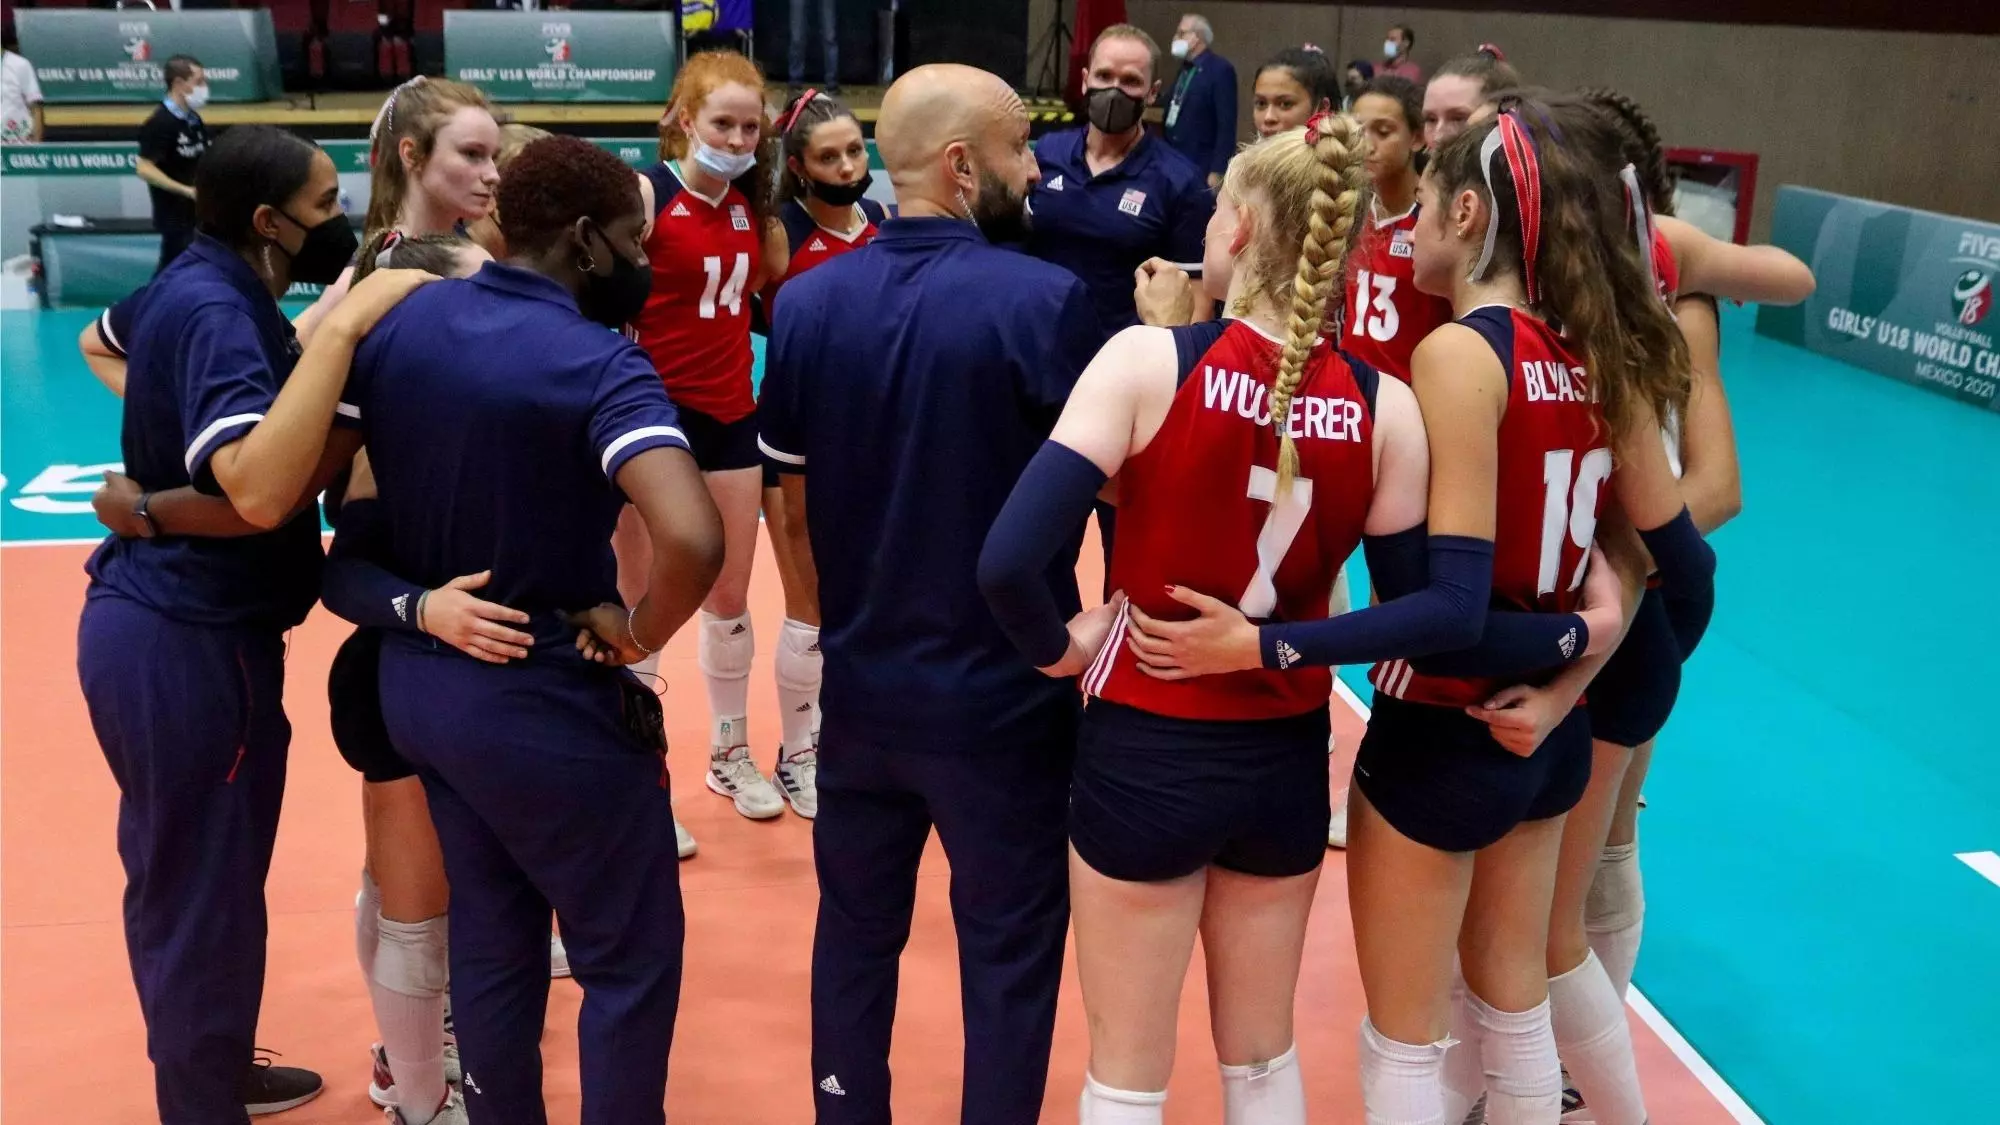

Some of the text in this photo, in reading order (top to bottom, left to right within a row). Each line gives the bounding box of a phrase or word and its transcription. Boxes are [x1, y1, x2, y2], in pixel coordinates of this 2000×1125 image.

[79, 68, 103, 81] U18
[106, 67, 147, 81] WORLD
[460, 68, 656, 81] GIRLS' U18 WORLD CHAMPIONSHIP
[9, 153, 49, 168] GIRLS'
[52, 154, 79, 168] U18
[80, 154, 125, 168] WORLD
[1121, 201, 1138, 213] USA
[734, 219, 748, 229] USA
[1392, 244, 1409, 255] USA
[699, 252, 750, 319] 14
[1352, 269, 1399, 342] 13
[1828, 307, 1877, 339] GIRLS'
[1877, 321, 1910, 350] U18
[1913, 331, 1972, 369] WORLD
[1935, 322, 1992, 348] VOLLEYBALL
[1914, 361, 1996, 399] MEXICO 2021
[1205, 365, 1363, 443] WUCERER
[1238, 464, 1313, 618] 7
[1276, 640, 1288, 669] adidas
[820, 1082, 846, 1096] adidas
